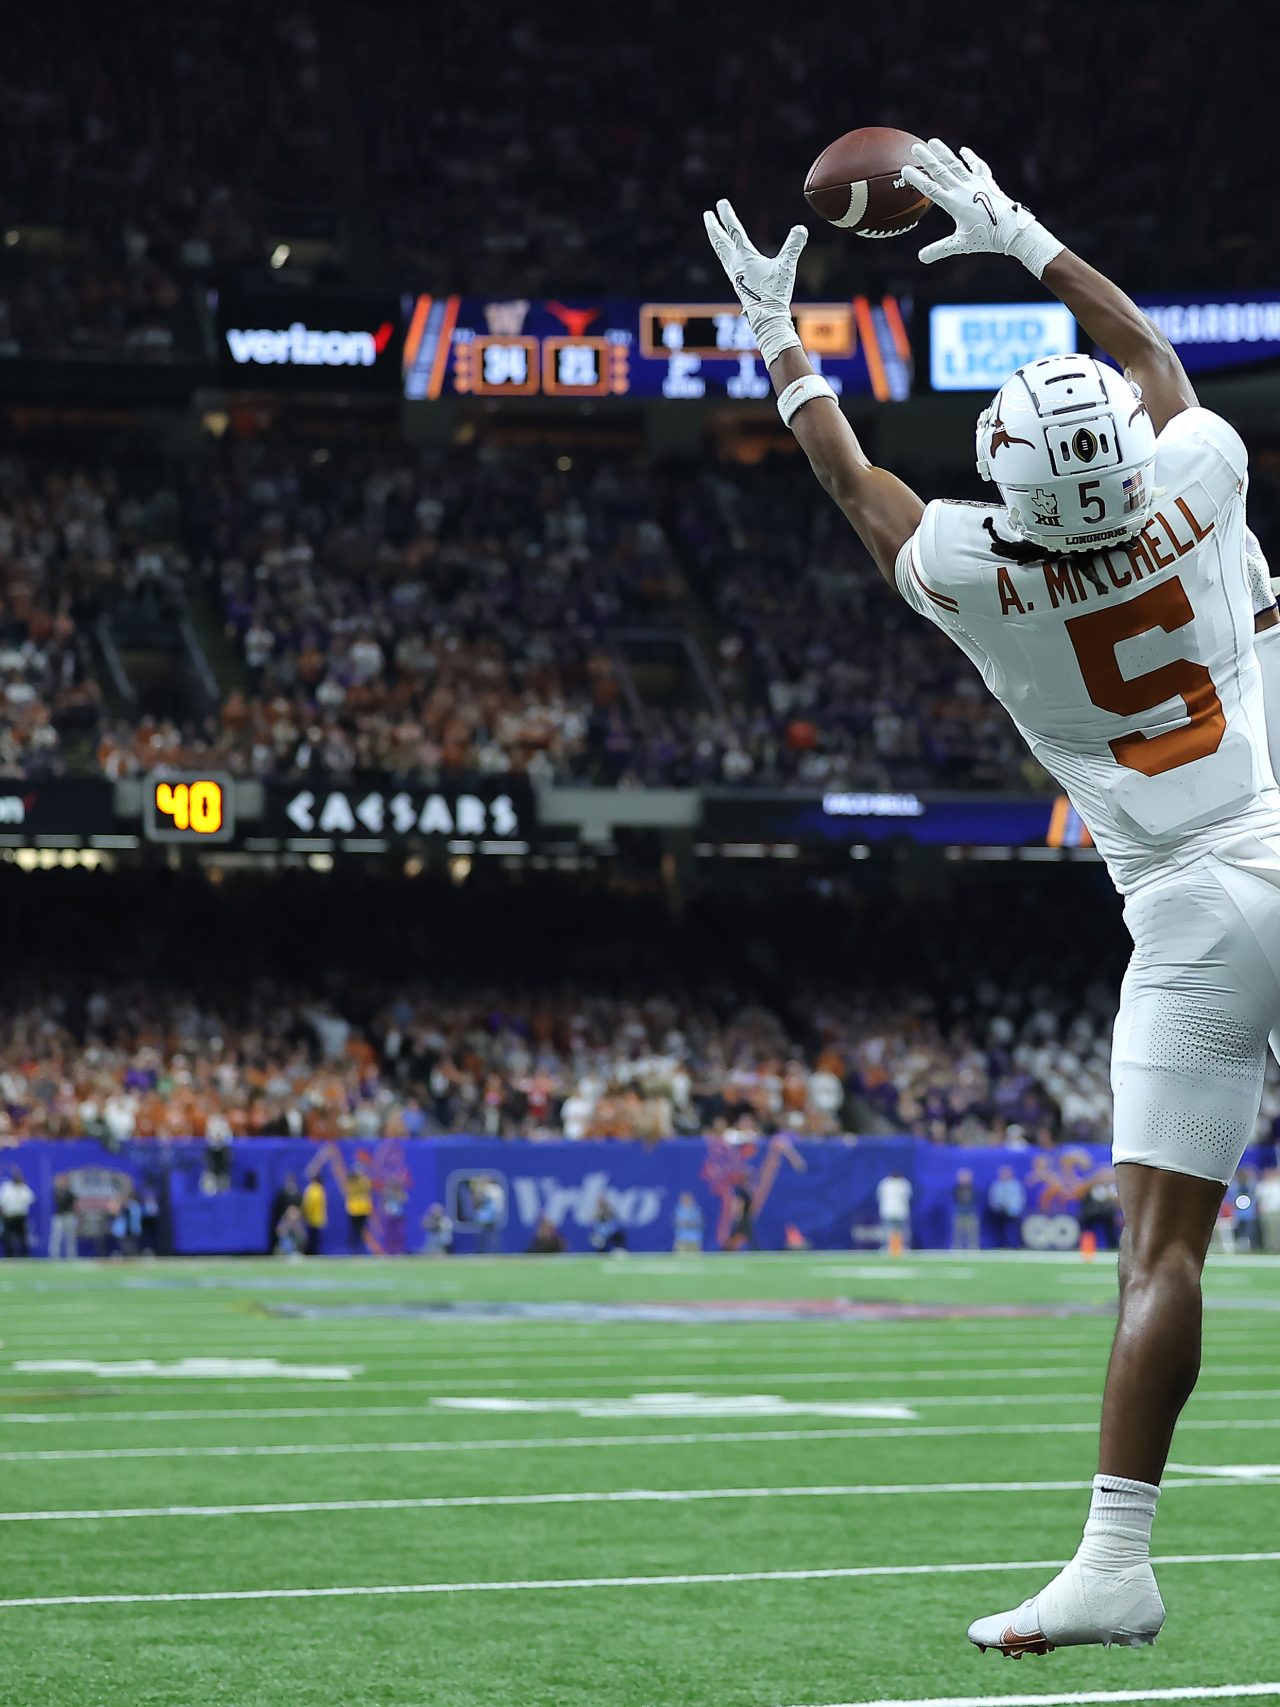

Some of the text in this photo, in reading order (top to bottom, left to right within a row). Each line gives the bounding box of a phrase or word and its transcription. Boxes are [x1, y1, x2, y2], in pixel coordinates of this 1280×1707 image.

[226, 322, 376, 366] verizon
[961, 320, 1043, 343] BUD
[1078, 480, 1106, 524] 5
[996, 496, 1215, 615] A. MICHELL
[1065, 526, 1128, 545] LONGHORNS
[1064, 575, 1227, 777] 5
[156, 780, 222, 833] 40
[285, 789, 519, 835] CAESARS
